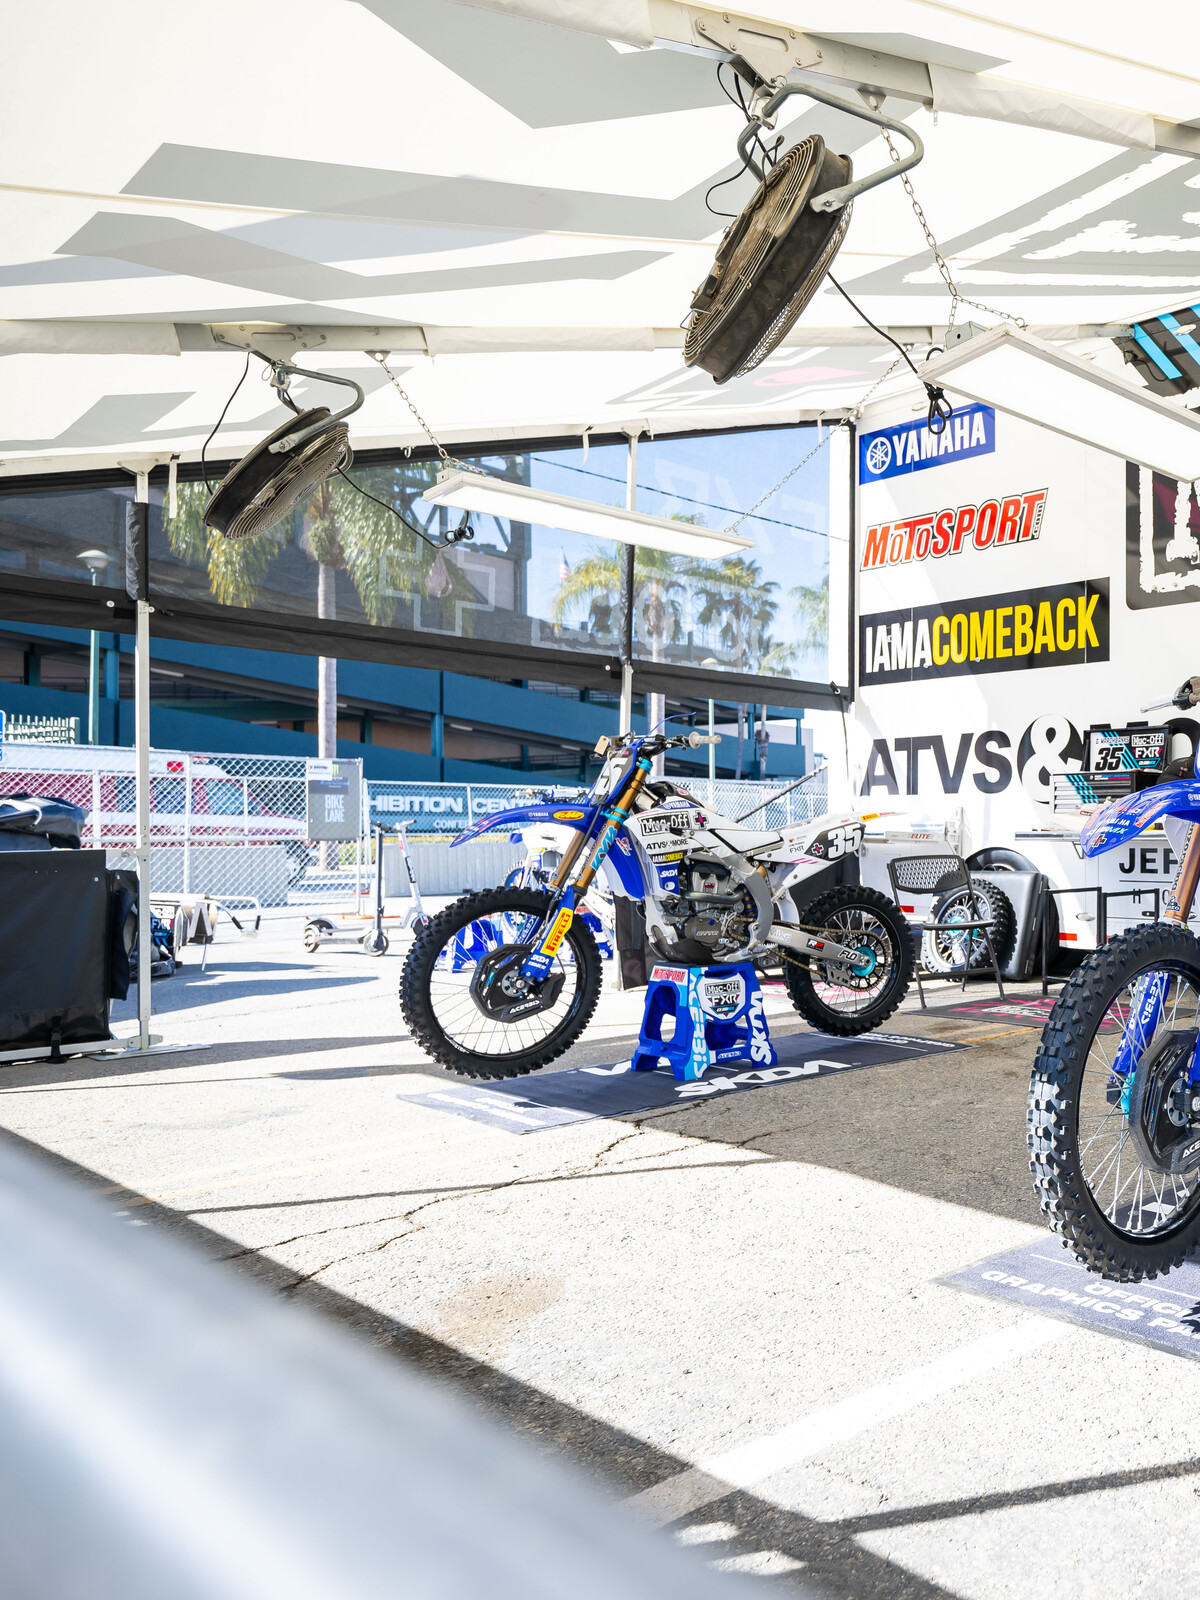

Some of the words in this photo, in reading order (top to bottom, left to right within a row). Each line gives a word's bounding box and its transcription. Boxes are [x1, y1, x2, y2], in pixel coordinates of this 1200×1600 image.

[892, 412, 987, 466] YAMAHA
[1133, 734, 1164, 746] Muc-Off
[1094, 747, 1126, 771] 35
[1135, 748, 1161, 758] FXR
[860, 730, 1013, 797] ATVS
[324, 795, 345, 809] BIKE
[368, 795, 463, 813] HIBITION
[324, 809, 345, 823] LANE
[828, 823, 861, 859] 35
[910, 832, 931, 840] ELITE
[545, 912, 572, 952] PIRELLI
[708, 982, 739, 995] Muc-Off
[712, 994, 738, 1006] FXR
[674, 1059, 853, 1098] SKDA
[981, 1270, 1141, 1321] GRAPHICS
